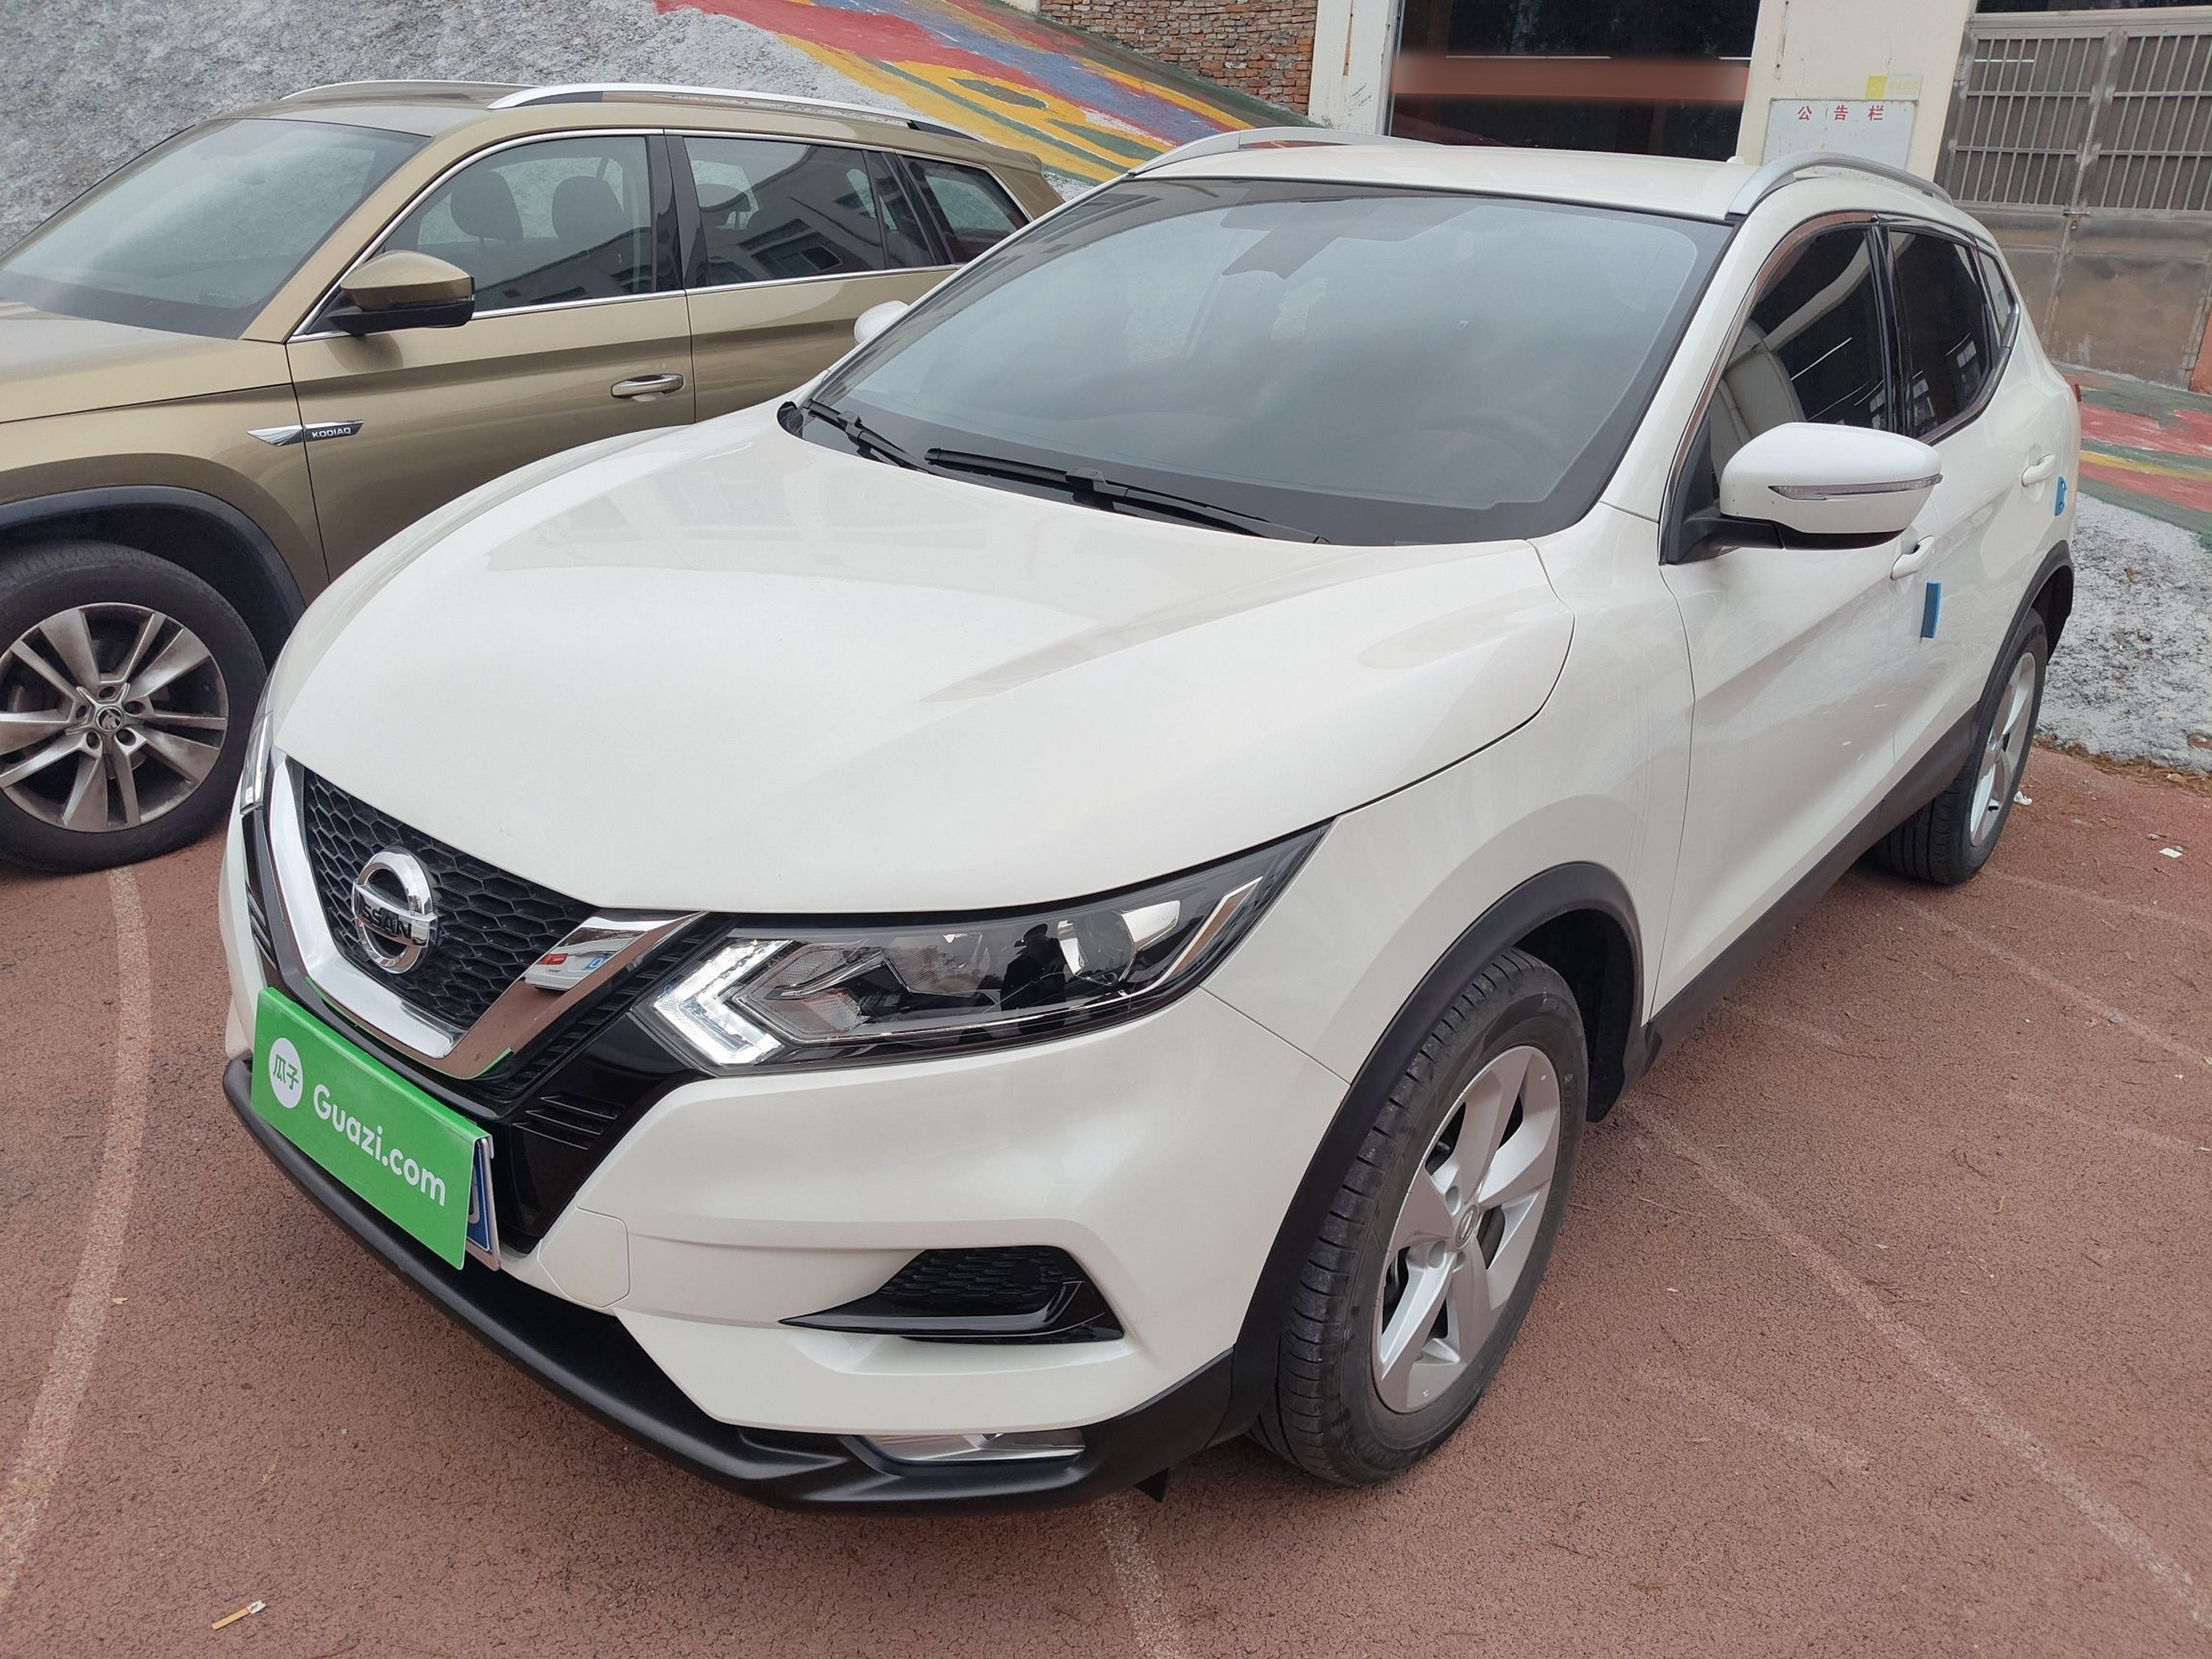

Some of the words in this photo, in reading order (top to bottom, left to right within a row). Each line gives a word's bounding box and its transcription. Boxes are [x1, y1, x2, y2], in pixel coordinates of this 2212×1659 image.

[1797, 105, 1884, 121] 公告栏
[312, 427, 351, 438] KODIAQ
[273, 1054, 299, 1091] 瓜子
[313, 1084, 446, 1207] Guazi.com
